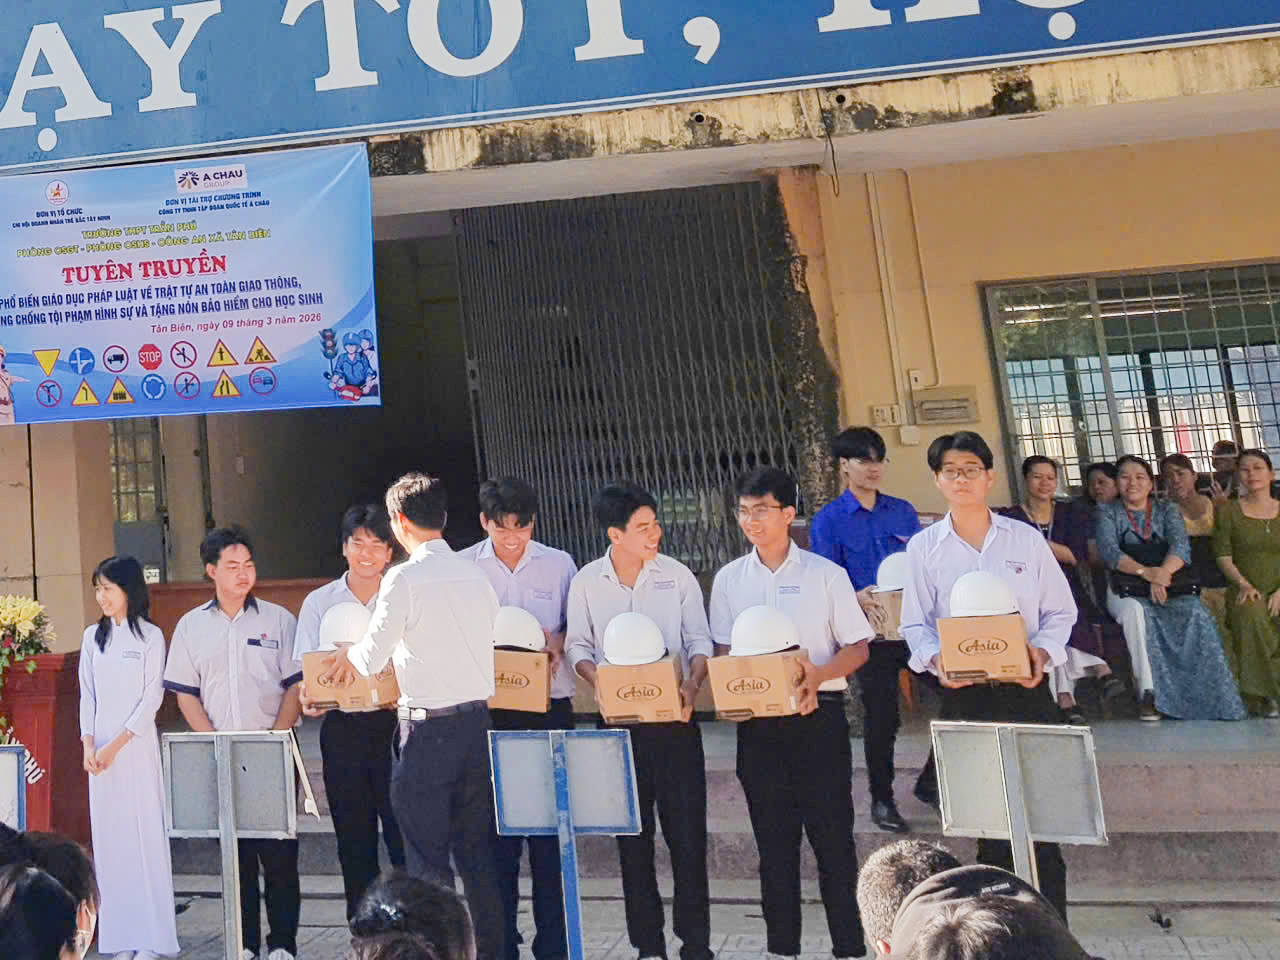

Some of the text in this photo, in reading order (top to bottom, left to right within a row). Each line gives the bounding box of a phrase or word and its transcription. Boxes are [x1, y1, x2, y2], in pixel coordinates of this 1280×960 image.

[203, 170, 243, 181] A CHAU
[62, 248, 227, 284] TUYÊN TRUYỀN
[19, 293, 40, 308] BIẾN
[41, 292, 63, 307] GIÁO
[65, 292, 85, 308] DỤC
[87, 289, 113, 304] PHÁP
[115, 287, 138, 303] LUẬT
[154, 284, 178, 301] TRẬT
[180, 283, 193, 299] TỰ
[194, 284, 208, 296] AN
[211, 279, 236, 294] TOÀN
[238, 278, 262, 292] GIAO
[264, 275, 302, 291] THÔNG,
[15, 309, 46, 326] CHỐNG
[48, 311, 63, 326] TỘI
[65, 309, 92, 324] PHẠM
[94, 306, 118, 320] HÌNH
[120, 305, 134, 321] SỰ
[135, 303, 148, 318] VÀ
[150, 302, 176, 319] TẶNG
[178, 300, 199, 315] NÓN
[201, 297, 221, 313] BẢO
[251, 296, 271, 309] CHO
[275, 293, 296, 310] HỌC
[298, 292, 324, 306] SINH
[150, 324, 168, 334] Tân
[196, 321, 220, 332] ngày
[222, 319, 234, 328] 09
[236, 317, 264, 329] tháng
[266, 316, 273, 326] 3
[275, 315, 296, 325] năm
[298, 312, 322, 323] 2026
[139, 351, 161, 363] STOP
[965, 639, 1000, 653] Asia
[496, 672, 524, 687] Asia
[733, 678, 764, 692] Asia
[623, 685, 656, 699] Asia
